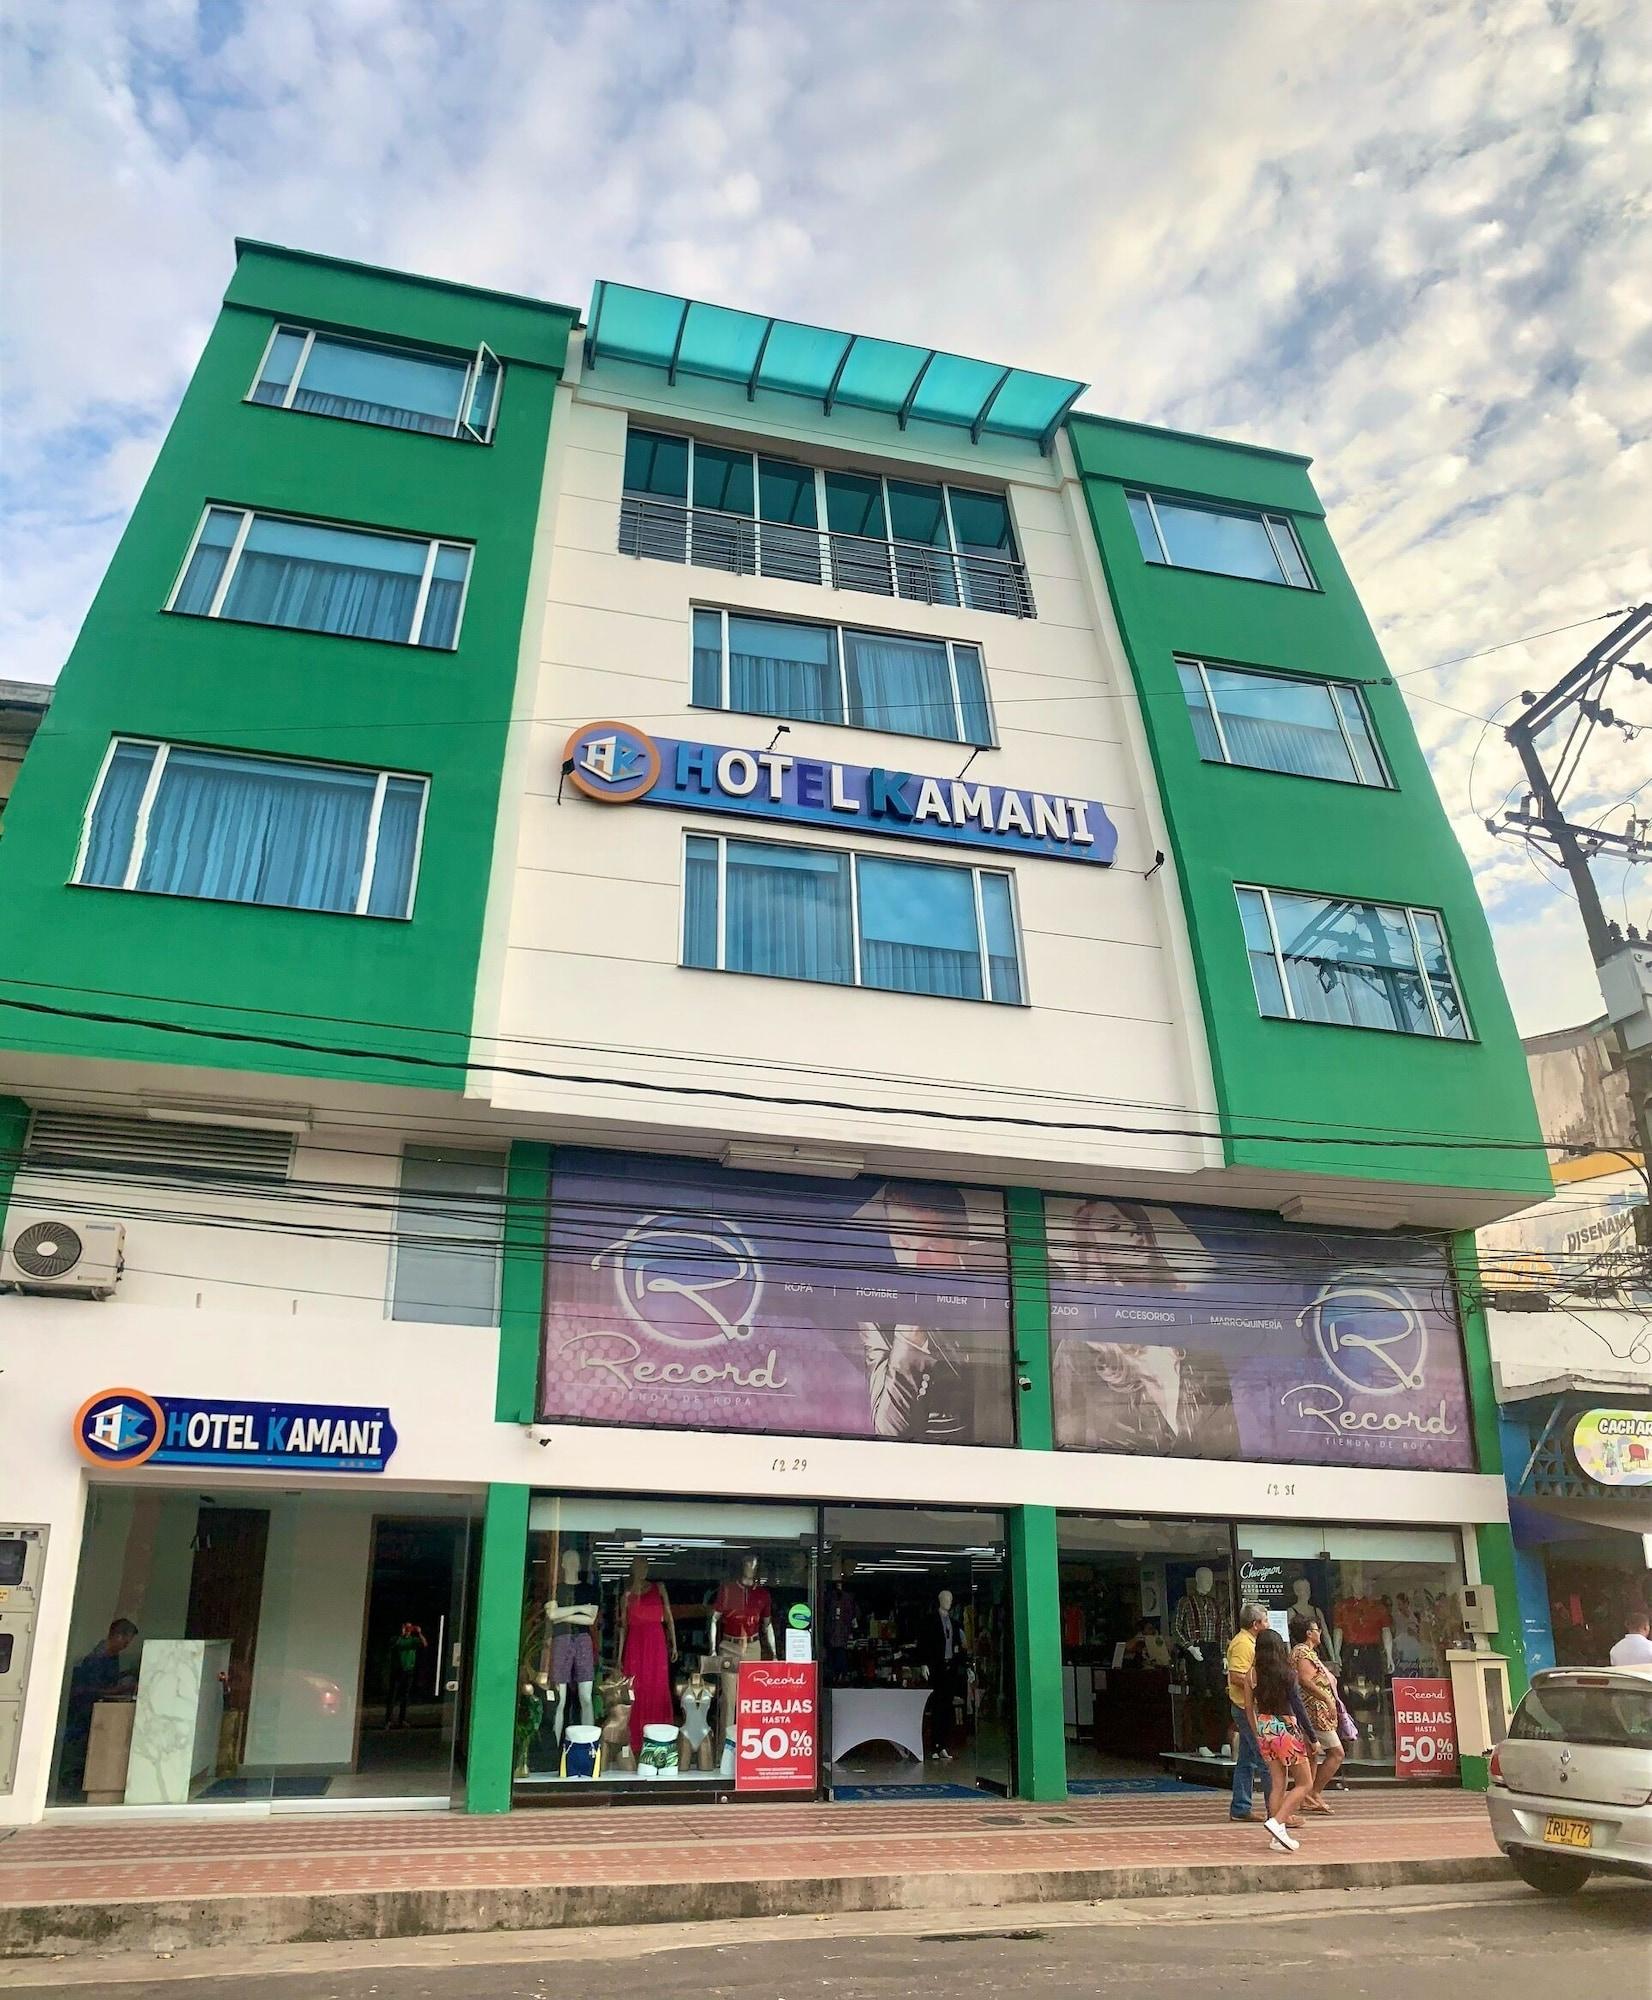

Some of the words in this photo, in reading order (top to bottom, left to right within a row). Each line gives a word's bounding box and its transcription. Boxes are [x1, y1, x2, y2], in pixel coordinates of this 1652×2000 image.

[675, 743, 861, 813] HOTEL
[870, 768, 1094, 845] KAMANI
[1566, 1208, 1635, 1254] DISEÑAM
[856, 1286, 899, 1300] HOMBRE
[936, 1294, 968, 1306] MUJER
[1114, 1309, 1176, 1323] ACCESORIOS
[559, 1331, 788, 1391] Record
[713, 1396, 752, 1406] ROPA
[1281, 1384, 1457, 1436] Record
[165, 1411, 260, 1450] HOTEL
[266, 1416, 384, 1455] KAMANI
[1325, 1437, 1371, 1448] TIENDA
[1379, 1439, 1394, 1449] DE
[792, 1459, 807, 1471] 29
[748, 1669, 807, 1687] Record
[1400, 1685, 1446, 1701] Record
[740, 1699, 813, 1714] REBAJAS
[762, 1716, 791, 1724] HASTA
[1397, 1710, 1453, 1724] REBAJAS
[1414, 1725, 1437, 1733] HASTA
[790, 1747, 813, 1757] DTO
[1436, 1752, 1454, 1761] DTO
